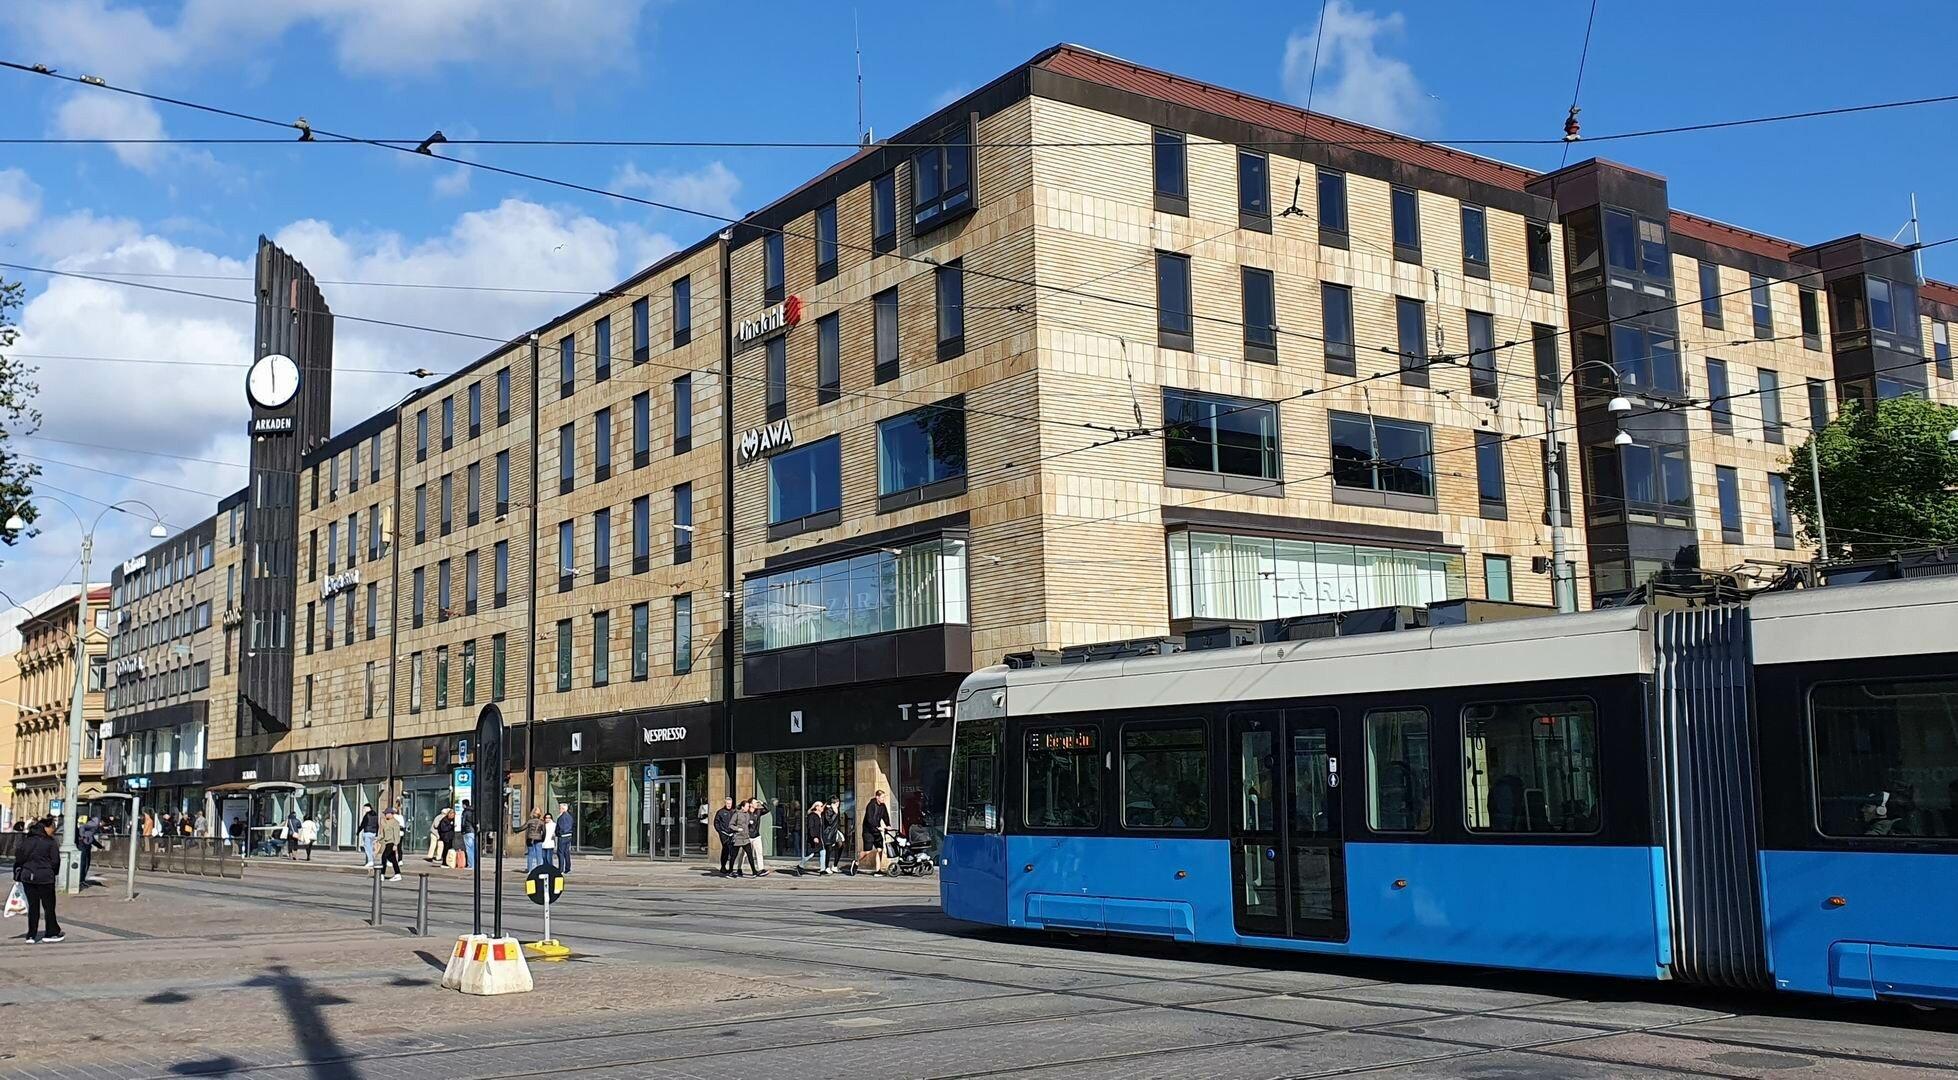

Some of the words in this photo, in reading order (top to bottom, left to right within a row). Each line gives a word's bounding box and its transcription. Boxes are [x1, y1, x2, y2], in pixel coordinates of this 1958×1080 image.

[255, 418, 291, 430] ARKADEN
[760, 419, 792, 451] AWA
[898, 700, 953, 721] TES
[298, 763, 321, 777] ZARA
